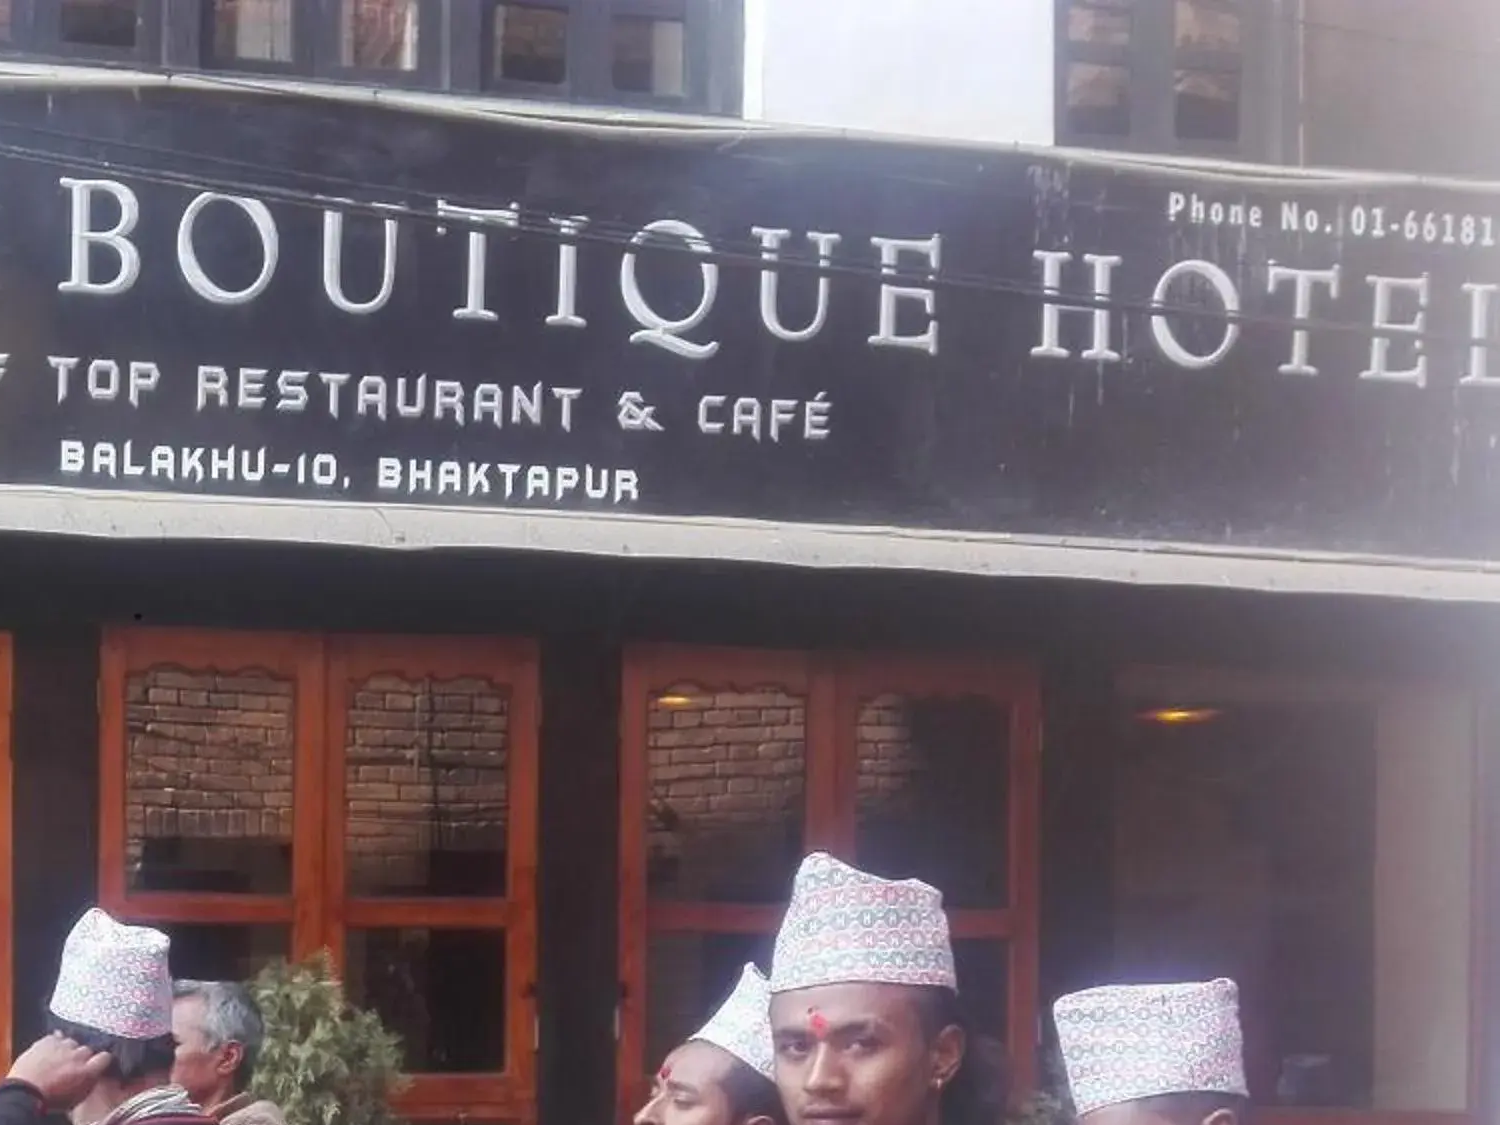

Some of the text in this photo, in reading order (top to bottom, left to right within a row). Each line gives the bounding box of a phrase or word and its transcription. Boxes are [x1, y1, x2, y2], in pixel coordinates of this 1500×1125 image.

[1167, 191, 1263, 228] Phone
[1280, 201, 1333, 234] No.
[57, 176, 943, 360] BOUTIQUE
[1030, 249, 1500, 389] HOTEL
[47, 355, 160, 408] TOP
[197, 365, 584, 433] RESTAURANT
[616, 391, 665, 431] &
[698, 391, 832, 443] CAFÉ
[377, 456, 640, 503] BHAKTAPUR
